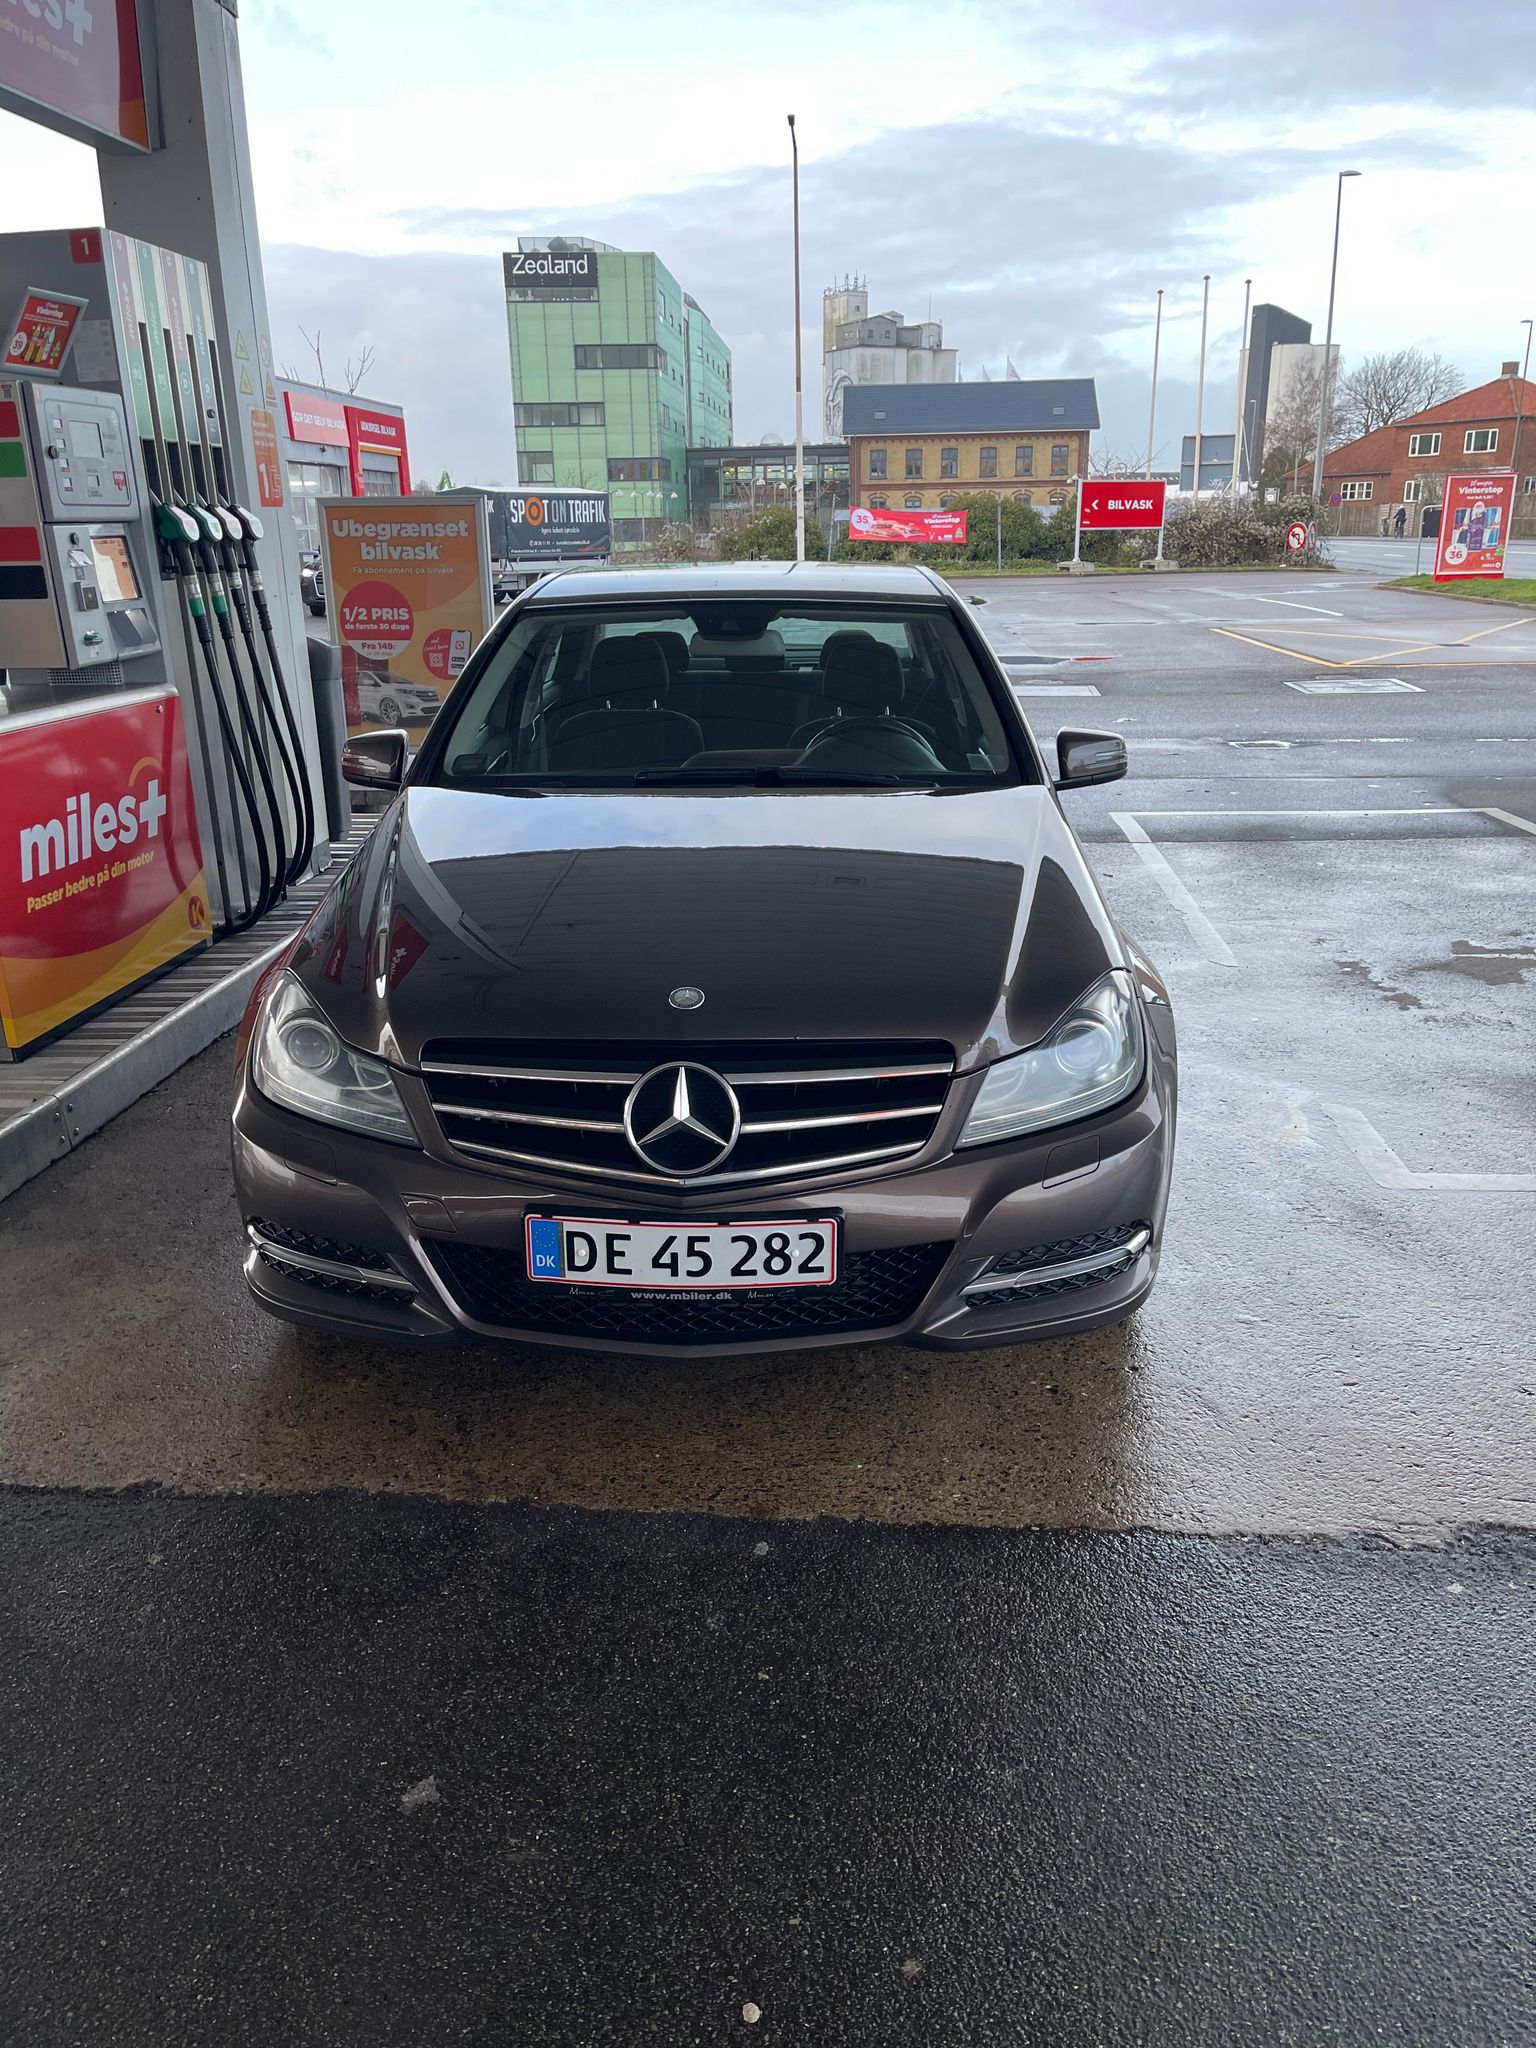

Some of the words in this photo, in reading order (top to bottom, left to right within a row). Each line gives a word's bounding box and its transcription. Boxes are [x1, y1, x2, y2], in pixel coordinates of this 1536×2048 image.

[80, 238, 90, 256] 1
[511, 254, 589, 275] Zealand
[13, 339, 24, 350] 39
[1458, 486, 1504, 495] Vinterstop
[552, 499, 567, 523] ON
[568, 499, 606, 523] TRAFIK
[1107, 499, 1154, 510] BILVASK
[855, 514, 869, 524] 35
[332, 519, 469, 541] Ubegrænset
[1449, 550, 1463, 560] 36
[364, 566, 413, 574] abonnement
[343, 606, 369, 622] 1/2
[371, 607, 410, 621] PRIS
[355, 622, 379, 631] første
[379, 622, 390, 631] 30
[361, 642, 377, 650] Fra
[20, 779, 167, 883] miles+
[26, 887, 64, 914] Passer
[65, 874, 96, 899] bedre
[97, 863, 110, 888] på
[111, 860, 126, 878] din
[127, 850, 155, 872] motor
[536, 1253, 556, 1268] DK
[565, 1230, 633, 1276] DE
[651, 1235, 713, 1278] 45
[730, 1231, 826, 1278] 282
[630, 1289, 732, 1301] www.mbiler.dk
